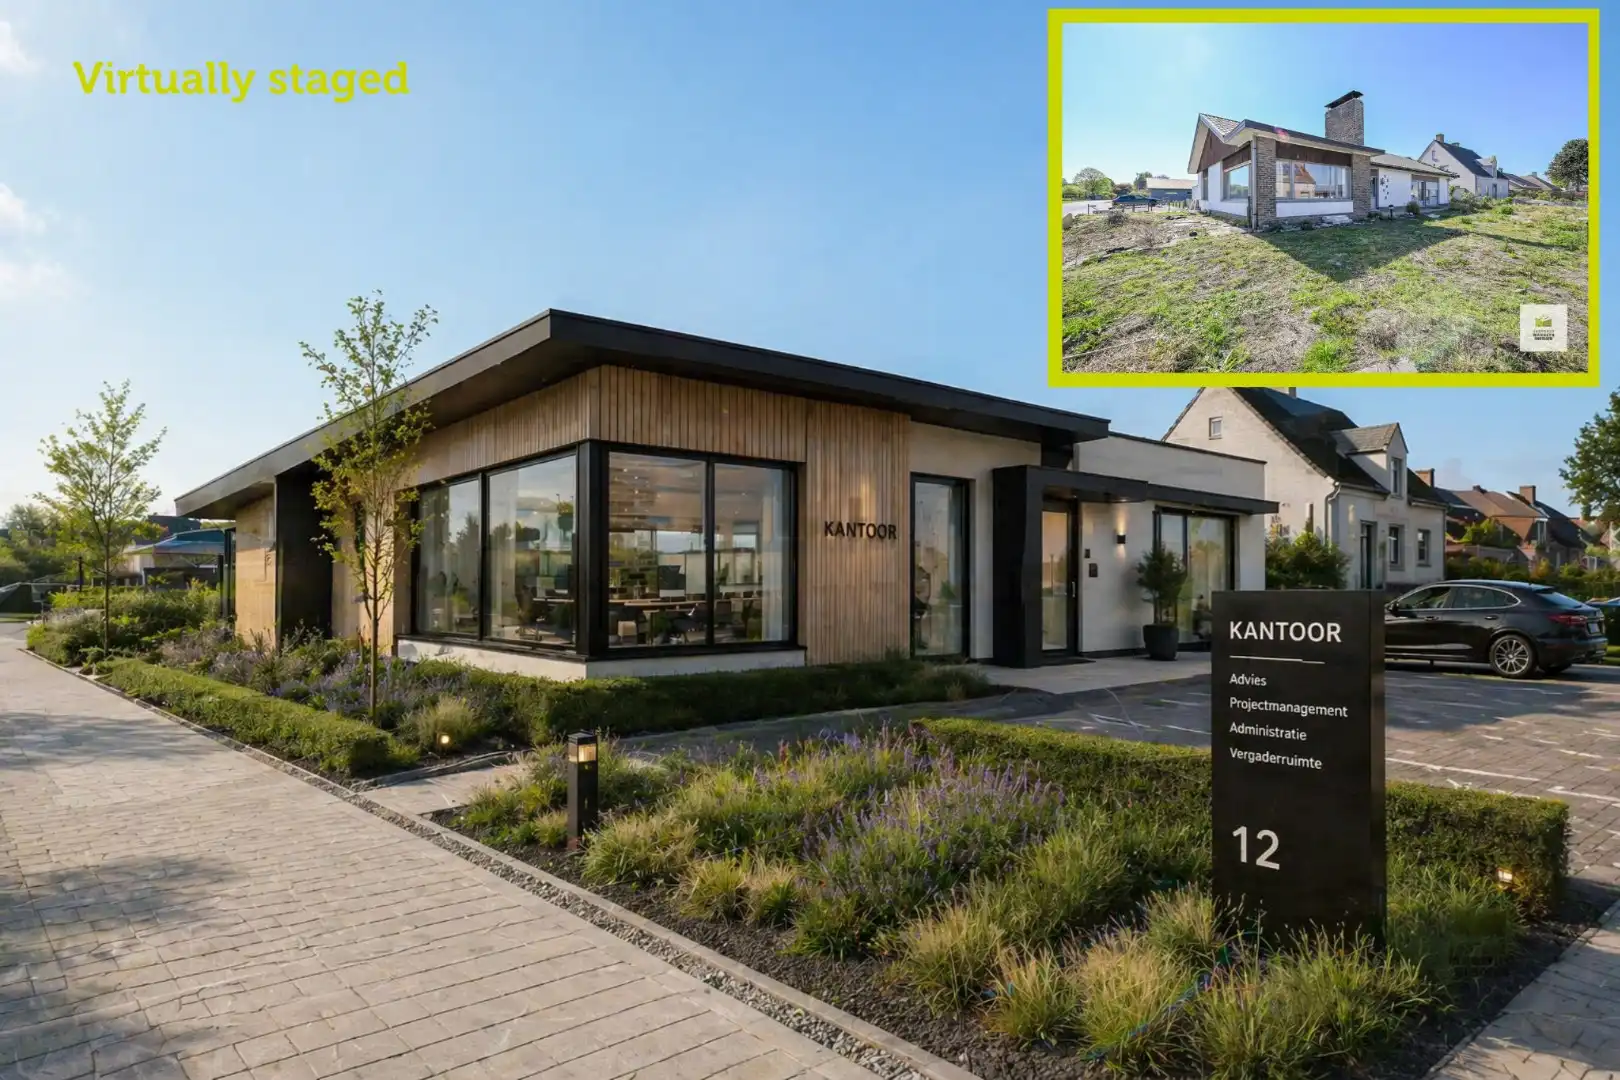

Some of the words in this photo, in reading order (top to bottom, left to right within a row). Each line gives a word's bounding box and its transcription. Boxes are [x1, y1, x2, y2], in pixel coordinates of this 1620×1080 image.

[824, 521, 897, 540] KANTOOR
[1229, 620, 1342, 643] KANTOOR
[1229, 673, 1267, 687] Advies
[1229, 697, 1348, 718] Projectmanagement
[1229, 722, 1307, 741] Administratie
[1230, 747, 1323, 770] Vergaderruimte
[1232, 825, 1281, 870] 12
